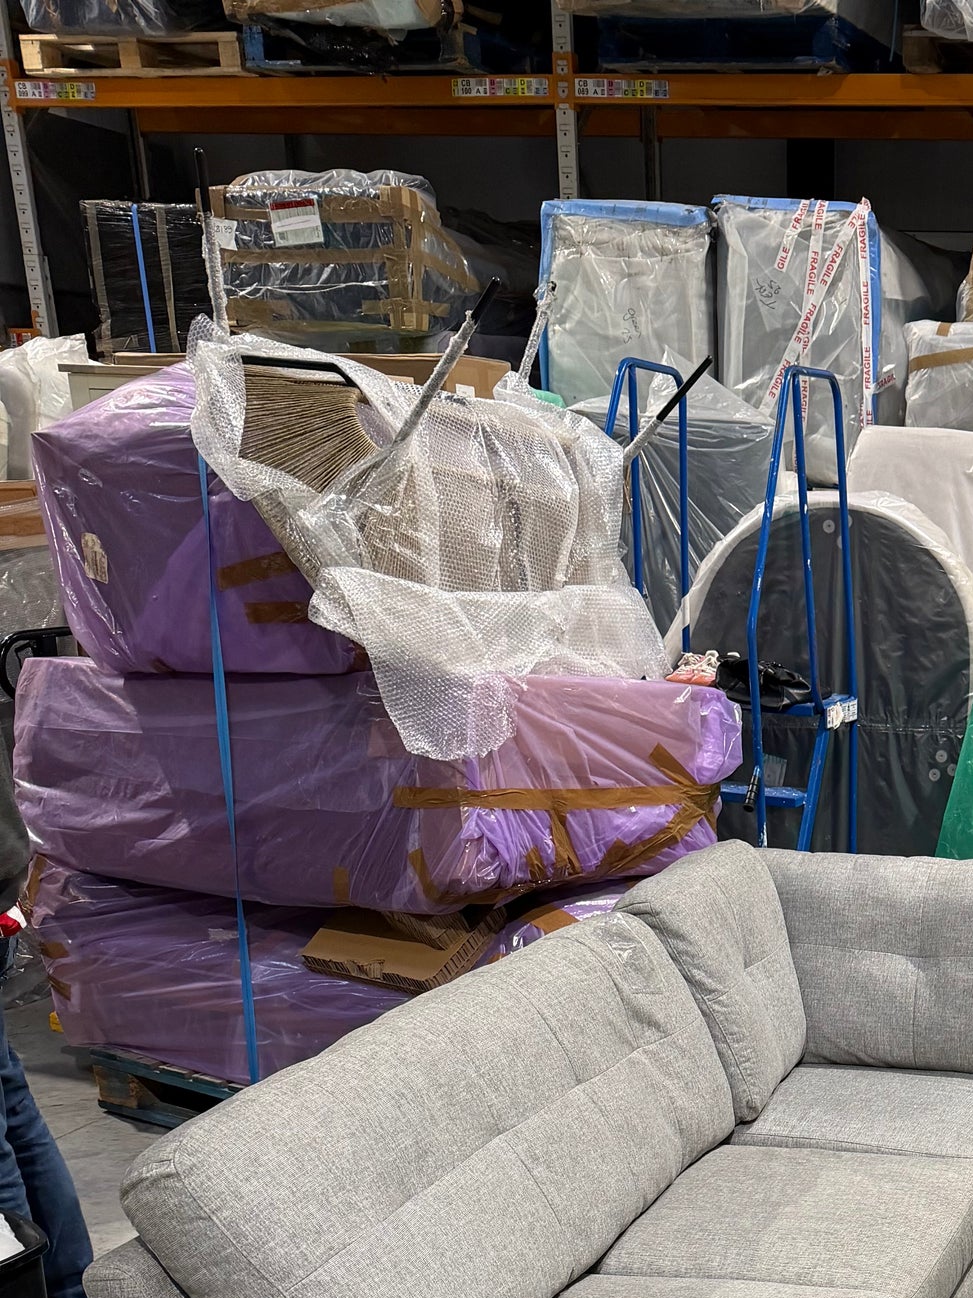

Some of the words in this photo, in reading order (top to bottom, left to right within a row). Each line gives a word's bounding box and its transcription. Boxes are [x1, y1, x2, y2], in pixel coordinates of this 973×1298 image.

[17, 82, 27, 90] CB
[461, 79, 471, 87] CB
[806, 250, 820, 296] FRAGILE
[820, 243, 844, 287] FRAGILE
[794, 302, 817, 345] FRAGILE
[861, 281, 871, 326] FRAGILE
[863, 346, 872, 390] FRAGILE
